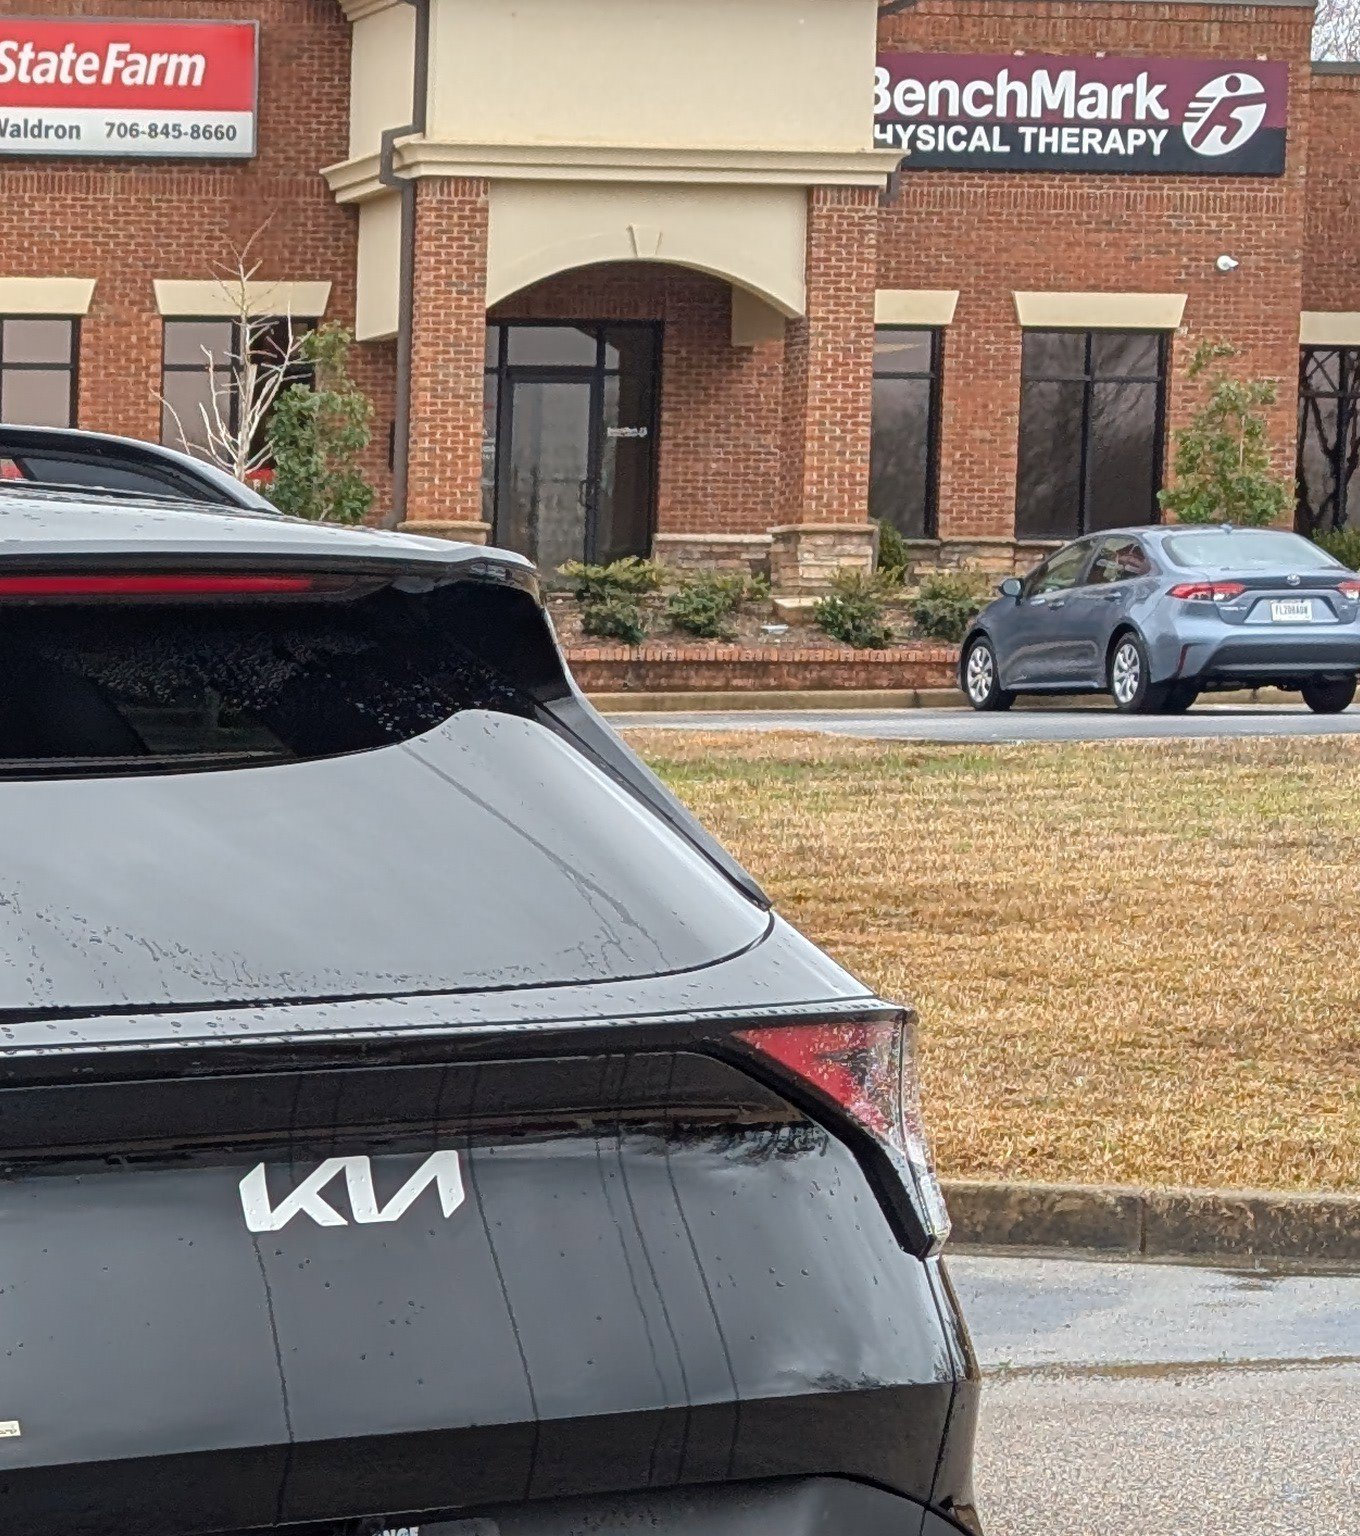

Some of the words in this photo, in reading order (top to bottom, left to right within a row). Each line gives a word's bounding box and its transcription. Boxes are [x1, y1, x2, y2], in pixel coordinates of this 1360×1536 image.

[873, 66, 1169, 120] BenchMark
[105, 121, 237, 141] 706-845-8660
[874, 123, 1011, 153] HYSICAL
[1018, 126, 1168, 156] THERAPY
[239, 1150, 465, 1232] KIA
